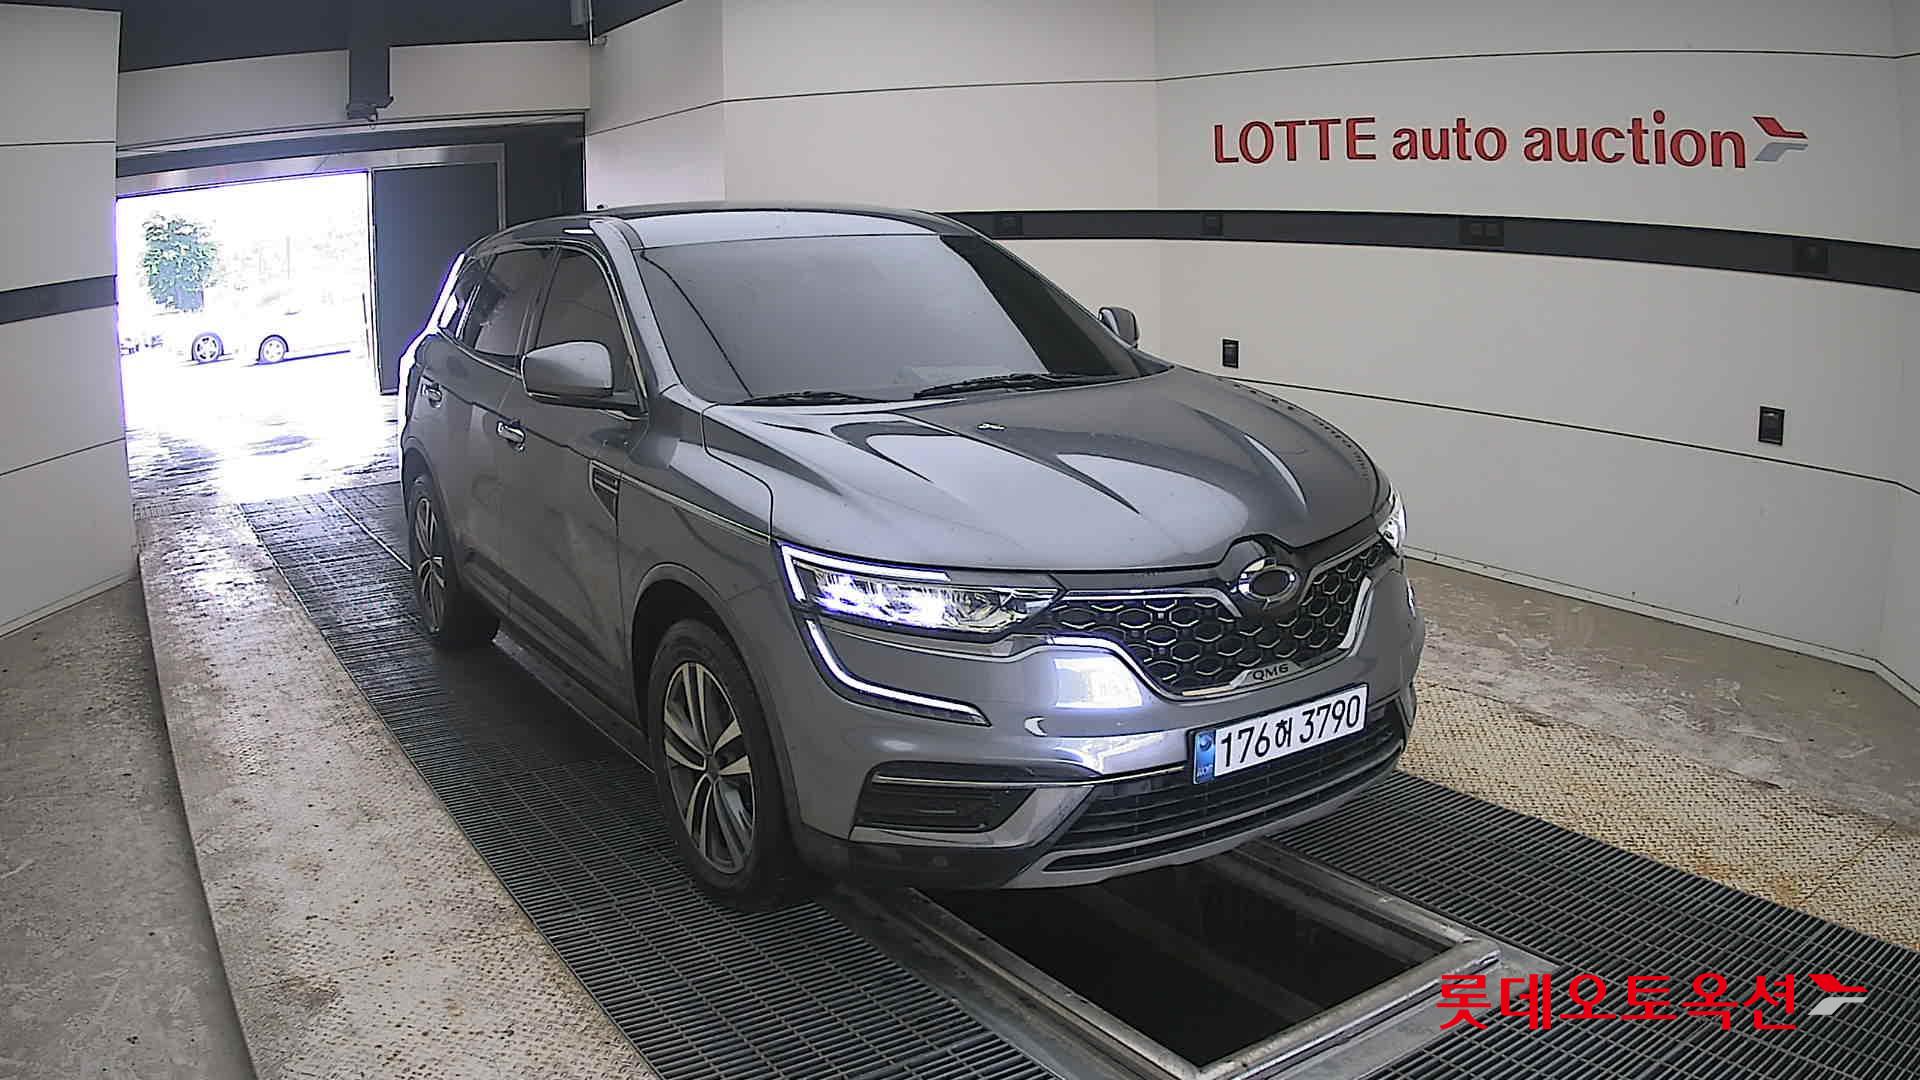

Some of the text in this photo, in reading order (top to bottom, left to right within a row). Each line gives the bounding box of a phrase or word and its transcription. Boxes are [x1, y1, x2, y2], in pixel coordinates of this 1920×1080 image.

[1213, 110, 1747, 169] LOTTE auto auction
[1252, 664, 1289, 681] QM6
[1220, 694, 1361, 768] 176허 3790
